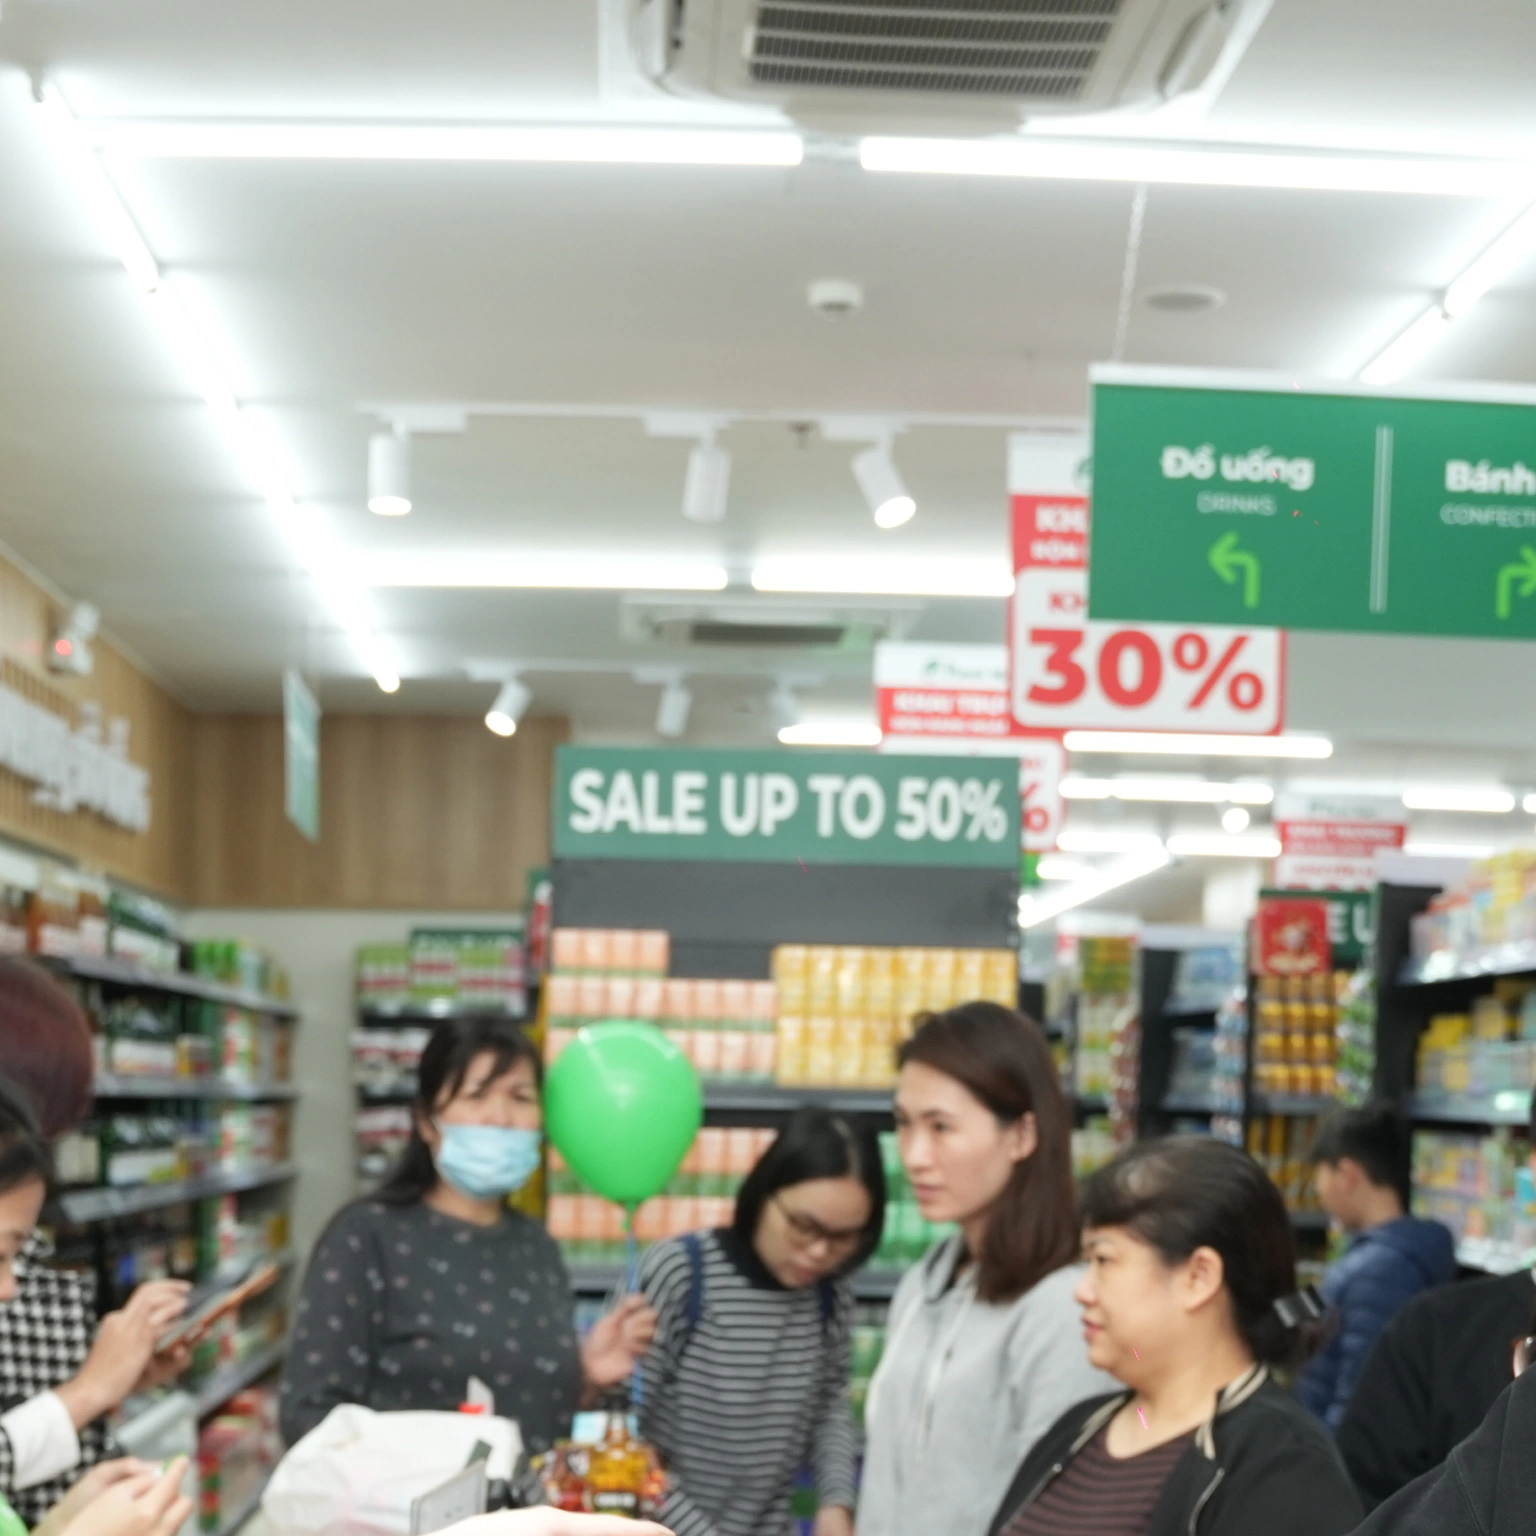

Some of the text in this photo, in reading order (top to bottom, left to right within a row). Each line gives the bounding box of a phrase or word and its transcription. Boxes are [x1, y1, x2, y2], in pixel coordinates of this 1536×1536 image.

[1027, 628, 1264, 710] 30%
[569, 768, 708, 836] SALE
[720, 772, 799, 837] UP
[808, 775, 886, 839] TO
[895, 776, 1008, 842] 50%
